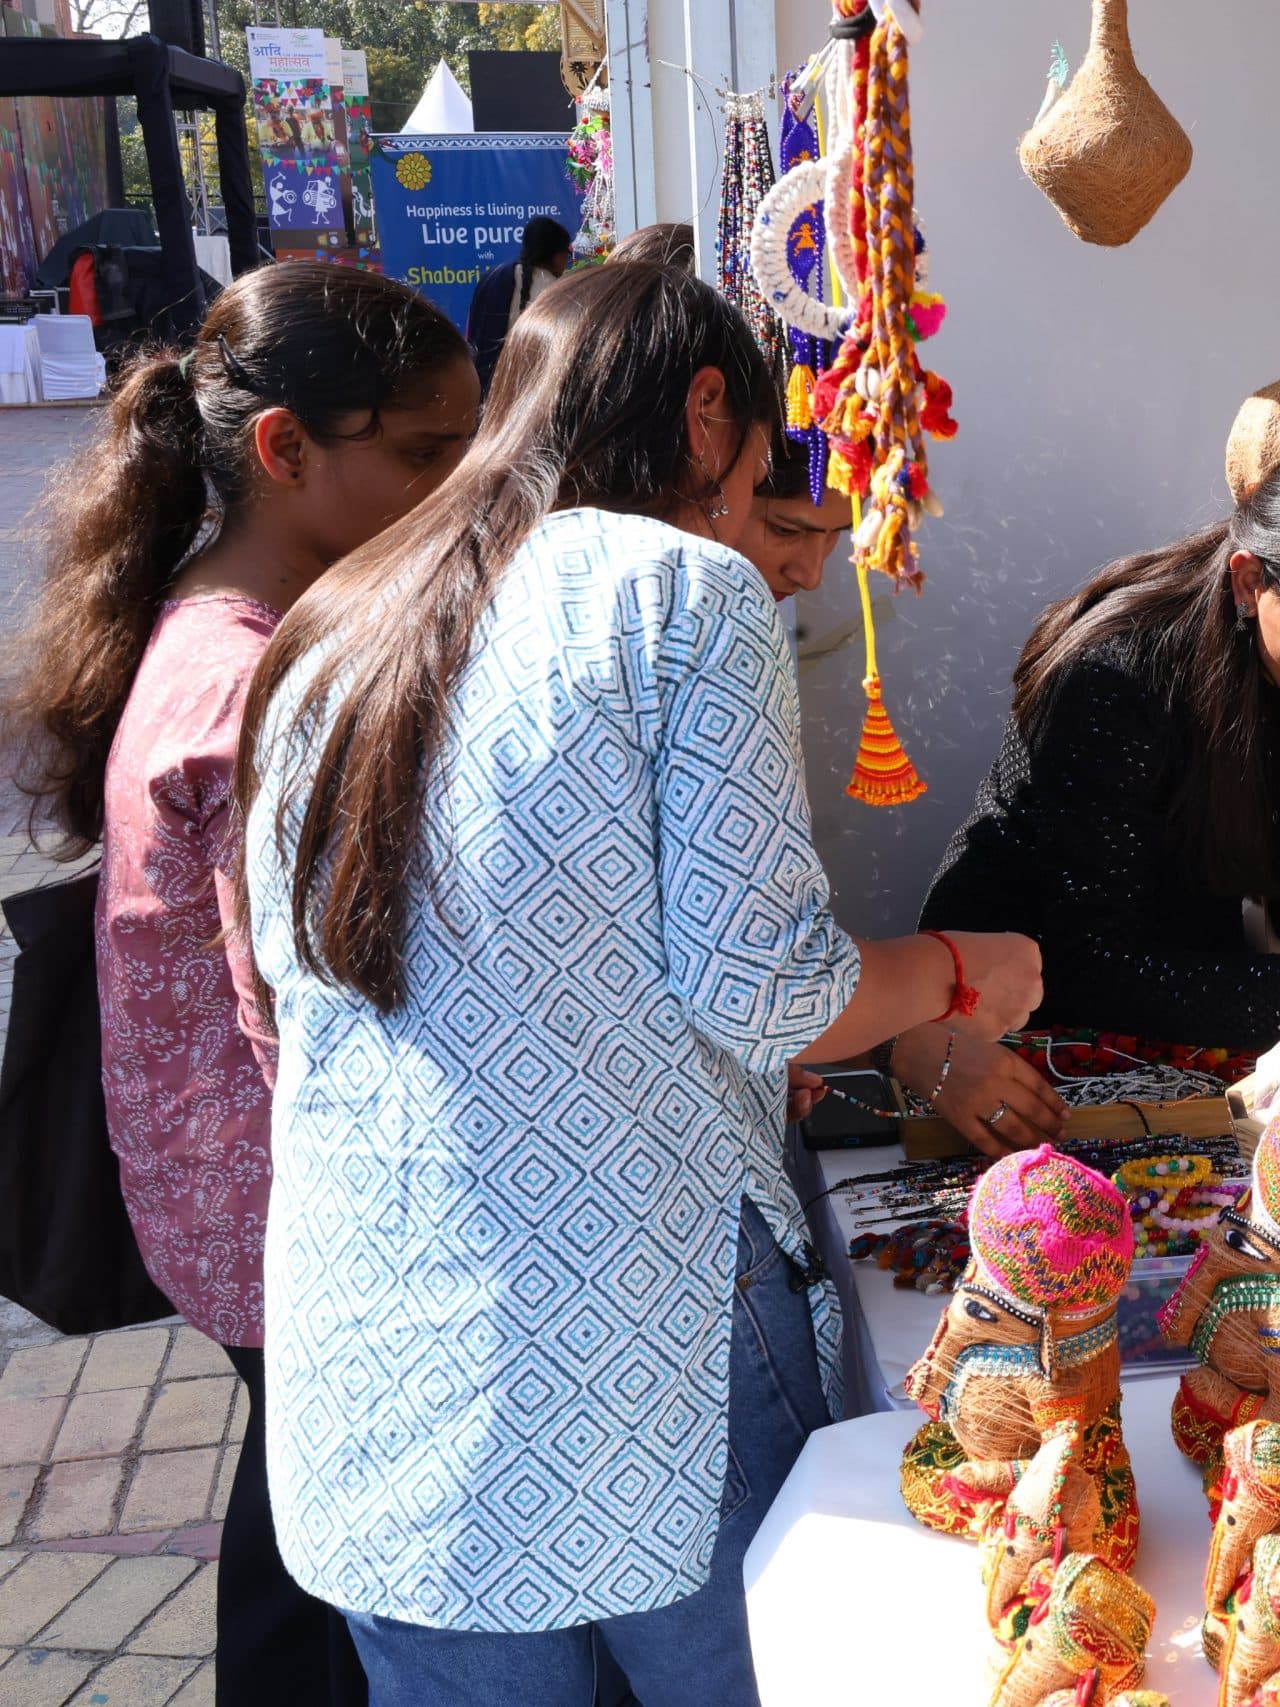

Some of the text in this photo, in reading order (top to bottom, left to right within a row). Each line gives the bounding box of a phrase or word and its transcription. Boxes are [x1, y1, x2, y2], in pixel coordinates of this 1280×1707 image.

[253, 43, 281, 56] आदि
[406, 202, 562, 220] Happiness is living pure.
[421, 222, 469, 244] Live
[477, 250, 495, 260] with
[406, 265, 481, 285] Shabari
